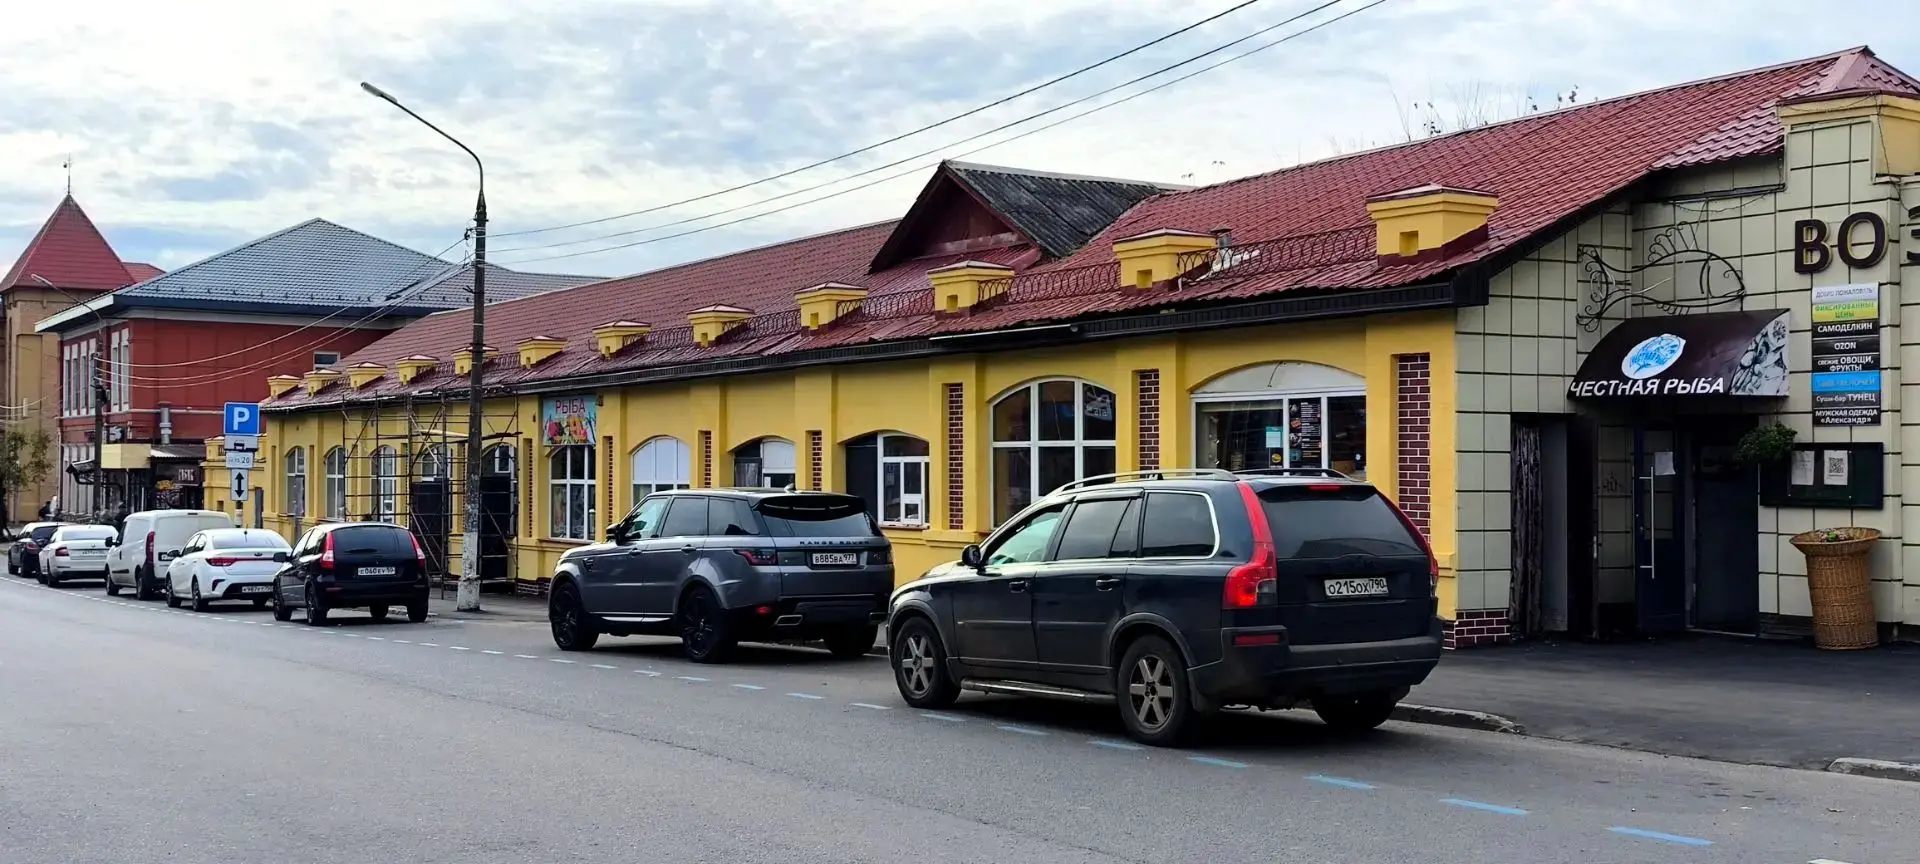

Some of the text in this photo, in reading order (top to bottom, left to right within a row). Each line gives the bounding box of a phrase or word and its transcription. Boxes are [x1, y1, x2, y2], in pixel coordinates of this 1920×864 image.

[1818, 322, 1872, 332] САМОДЕЛКИН
[1834, 342, 1856, 350] OZON
[1840, 356, 1874, 364] ОВОЩИ,
[1830, 364, 1862, 372] ФРУКТЫ
[1570, 377, 1724, 396] ЧЕСТНАЯ РЫБА
[1848, 394, 1876, 402] ТУНЕЦ
[556, 398, 586, 413] РЫБА
[1820, 416, 1872, 424] «Александр»
